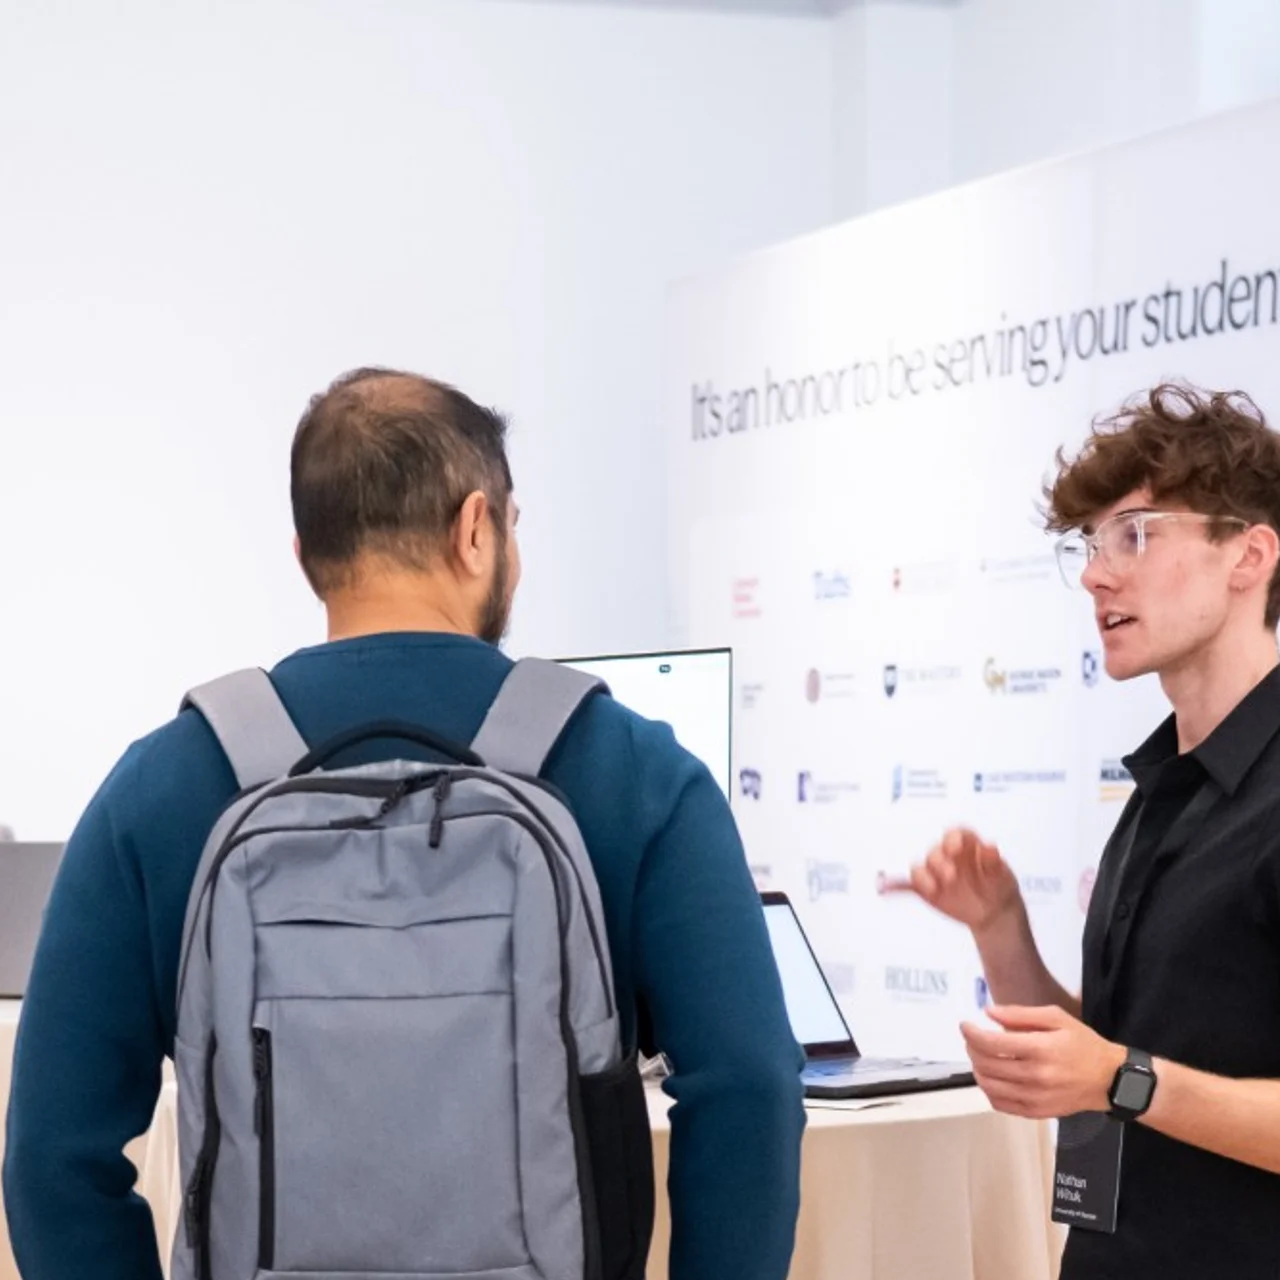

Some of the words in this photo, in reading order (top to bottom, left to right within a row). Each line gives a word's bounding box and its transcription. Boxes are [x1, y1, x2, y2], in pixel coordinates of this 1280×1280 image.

[726, 386, 760, 434] an
[765, 365, 848, 429] honor
[852, 360, 880, 408] to
[886, 337, 925, 402] be
[932, 311, 1049, 388] serving
[1054, 297, 1137, 383] your
[884, 964, 949, 996] HOLLINS
